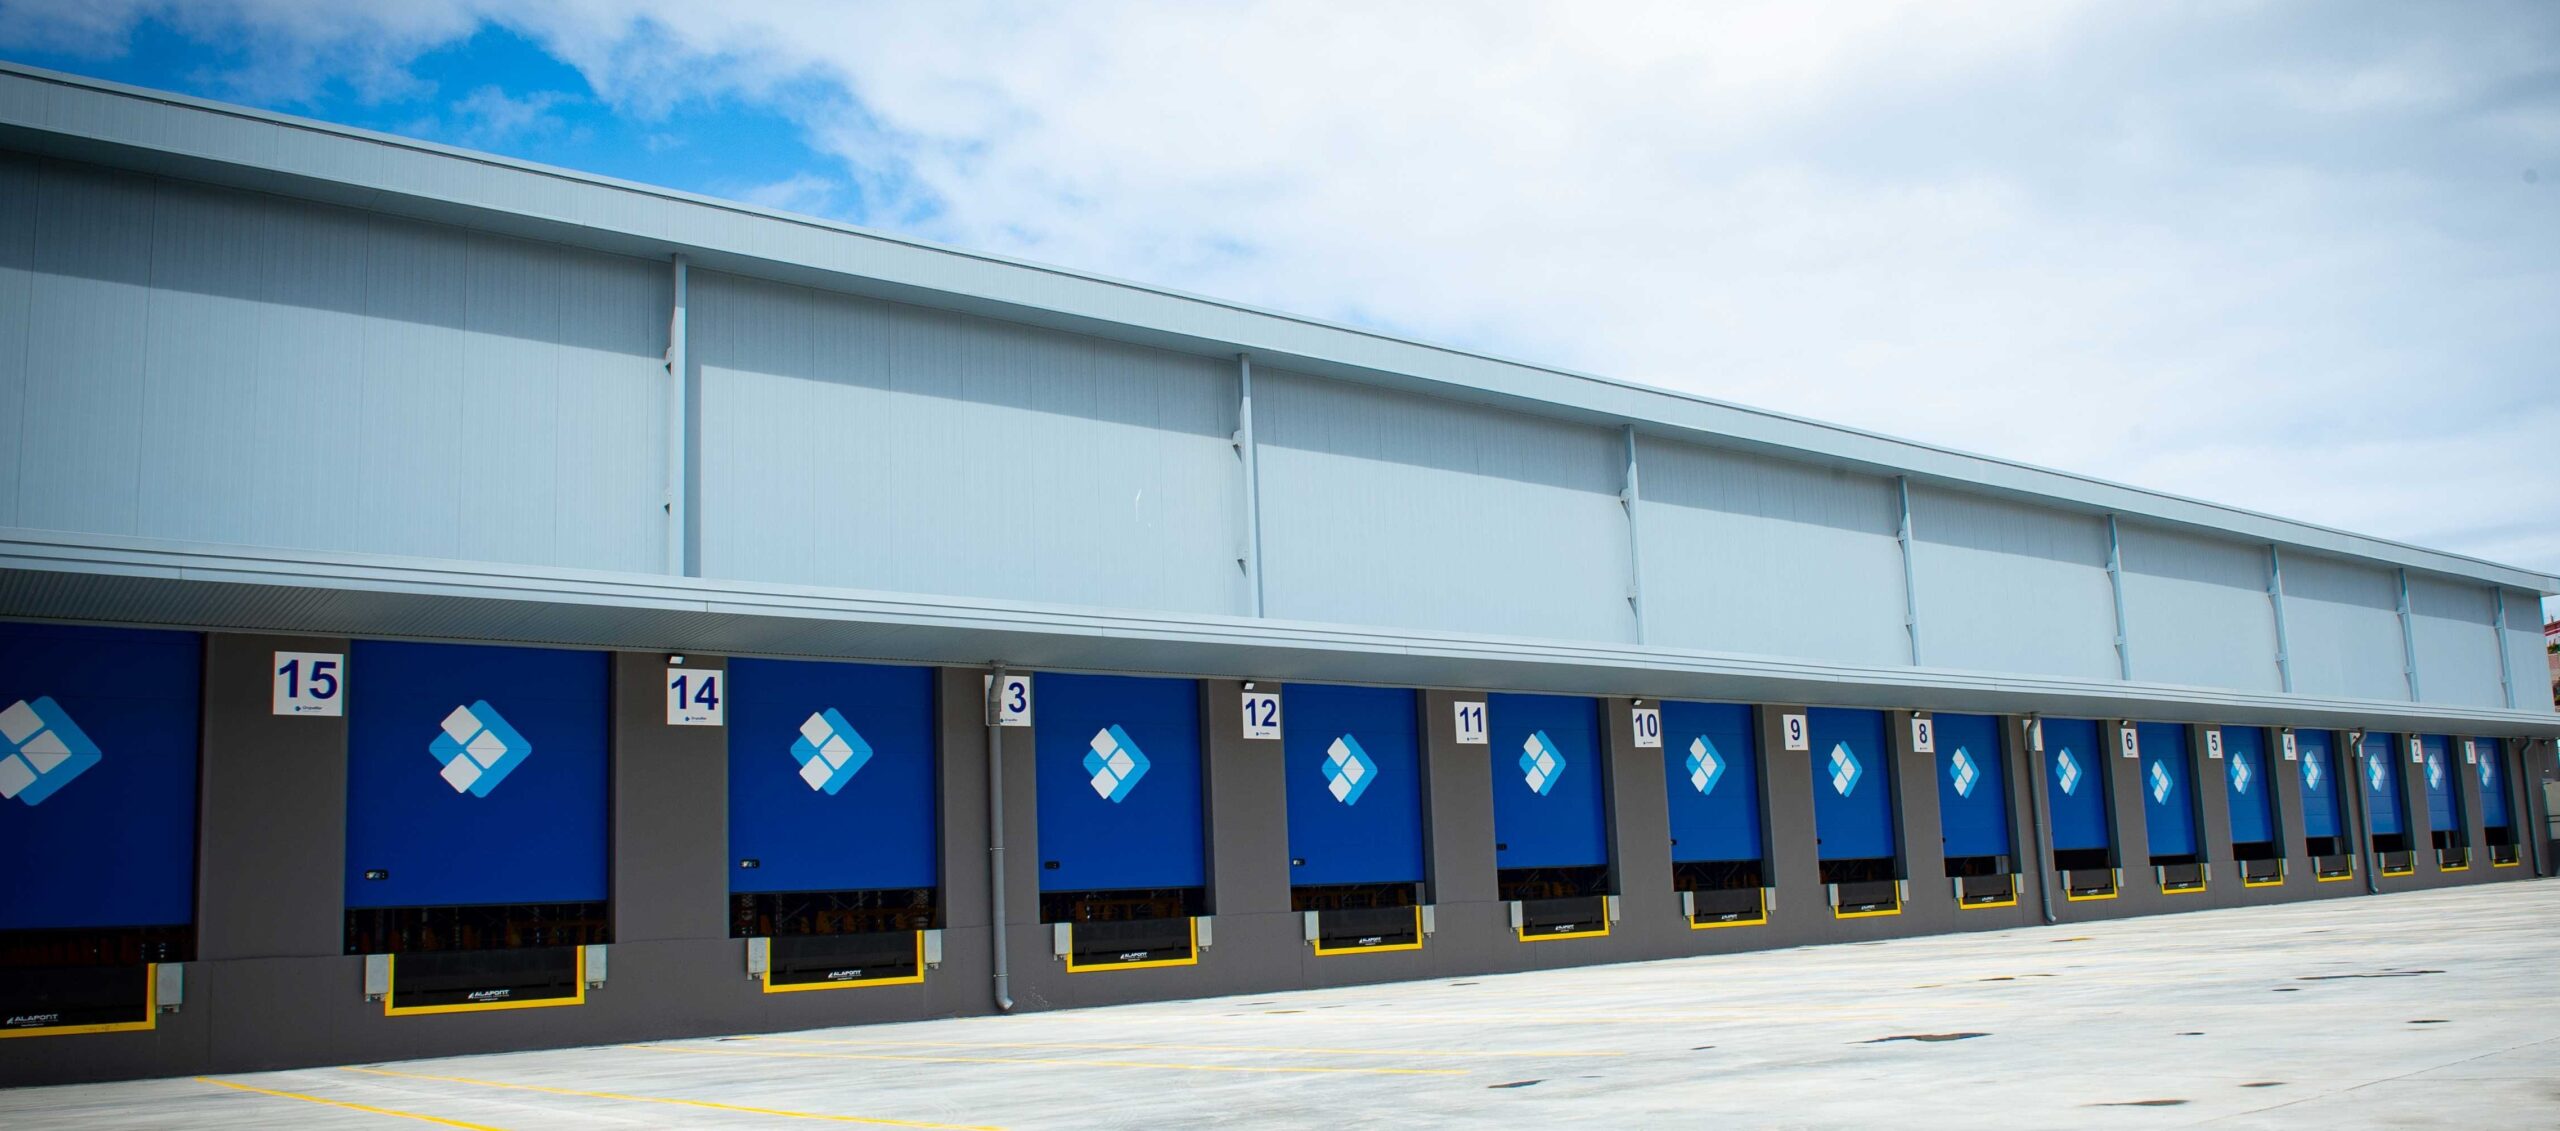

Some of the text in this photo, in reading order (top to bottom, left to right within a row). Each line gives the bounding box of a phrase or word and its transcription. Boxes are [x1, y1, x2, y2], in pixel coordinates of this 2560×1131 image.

[279, 659, 338, 700] 15
[671, 675, 719, 711] 14
[1008, 682, 1027, 713] 3
[1245, 698, 1277, 727] 12
[1460, 707, 1482, 733] 11
[1635, 713, 1657, 738] 10
[1790, 719, 1800, 741] 9
[1919, 723, 1928, 744] 8
[2126, 732, 2133, 750] 6
[2211, 734, 2218, 751] 5
[2286, 737, 2293, 753] 4
[2413, 742, 2419, 757] 2
[474, 989, 510, 997] ALAPONT
[14, 1013, 59, 1022] ALAPONT
